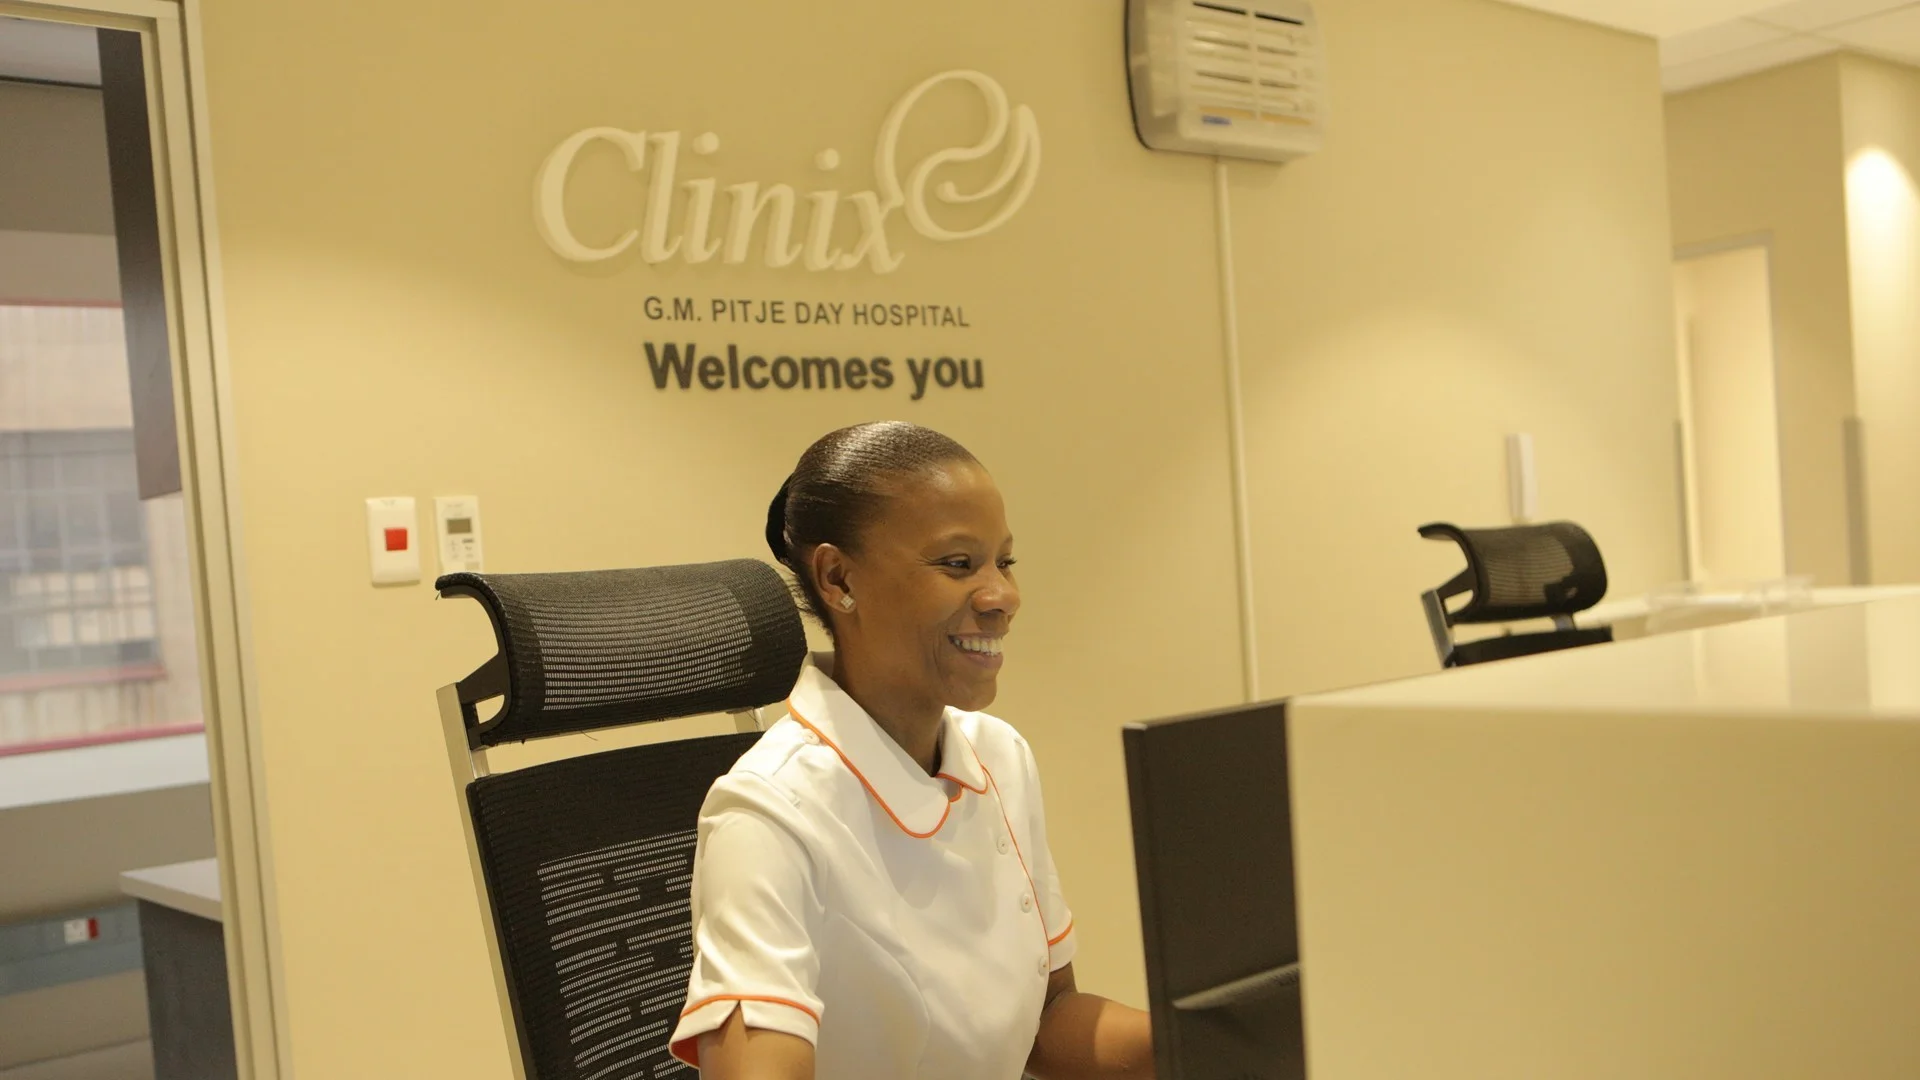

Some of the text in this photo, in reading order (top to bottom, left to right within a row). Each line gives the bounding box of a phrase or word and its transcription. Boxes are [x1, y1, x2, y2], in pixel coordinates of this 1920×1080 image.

[534, 125, 908, 275] Clinix
[643, 296, 970, 328] G.M. PITJE DAY HOSPITAL
[643, 341, 985, 401] Welcomes you
